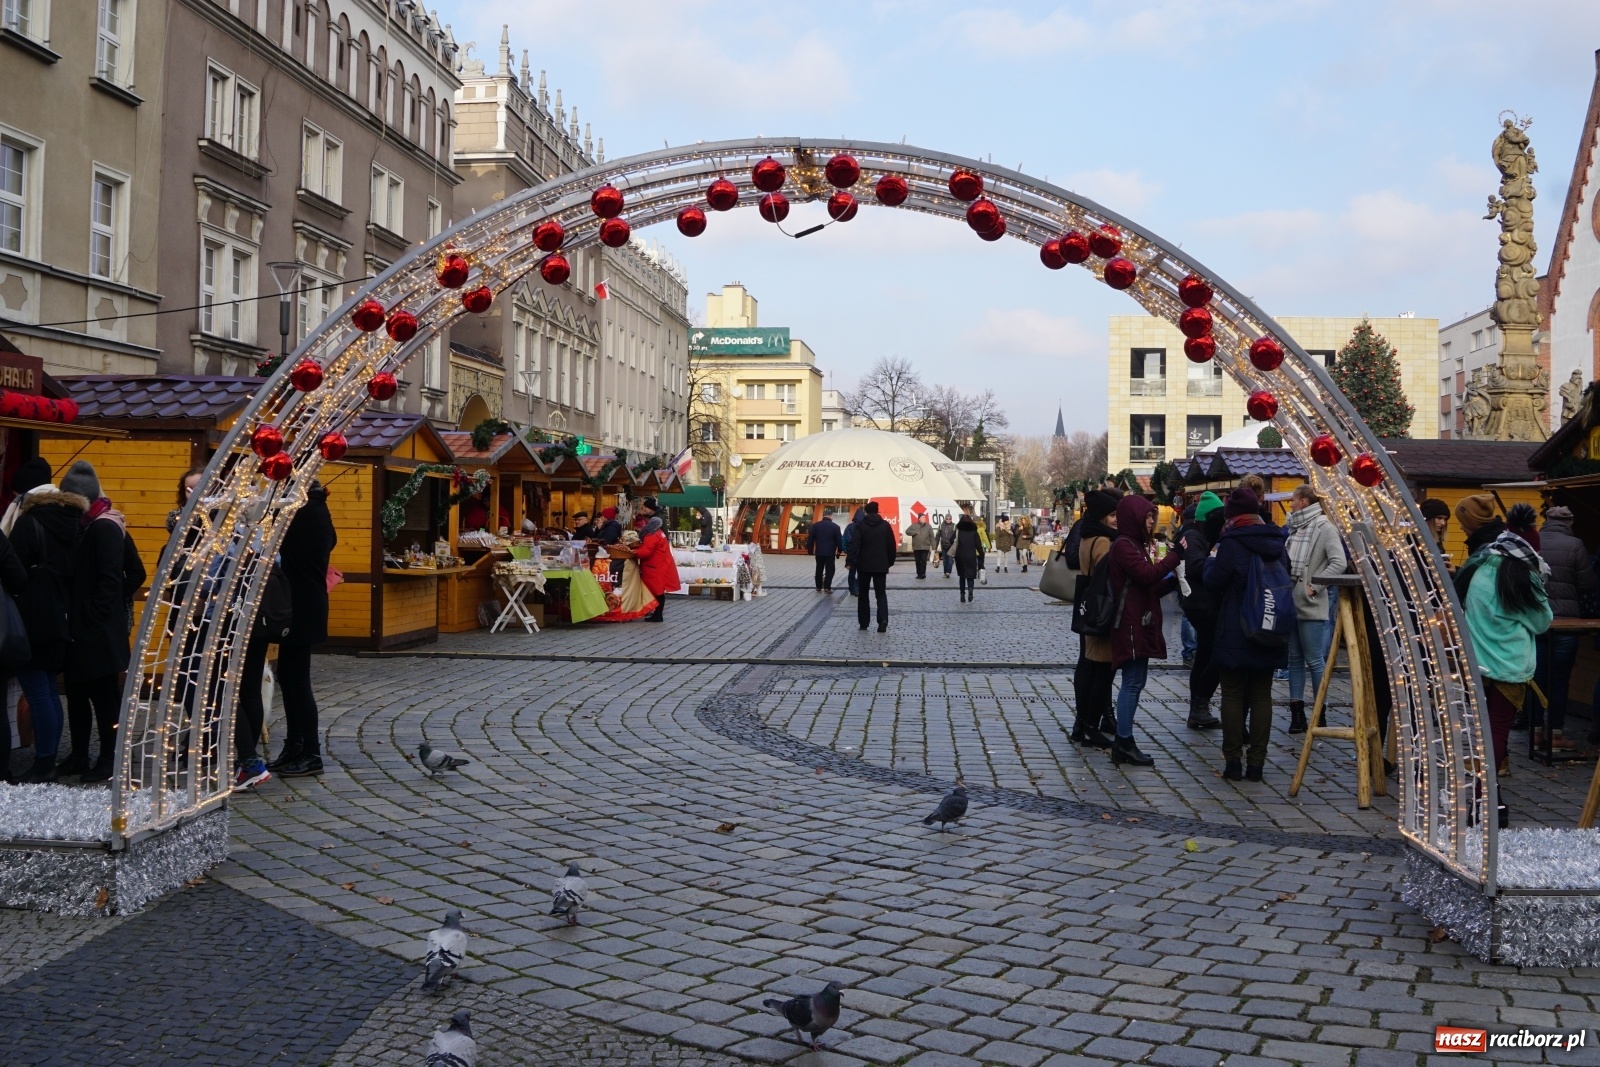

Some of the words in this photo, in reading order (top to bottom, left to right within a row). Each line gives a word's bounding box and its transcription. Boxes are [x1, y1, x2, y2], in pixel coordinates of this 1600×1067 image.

[710, 336, 764, 345] McDonald's
[803, 474, 830, 485] 1567
[1264, 588, 1276, 615] PUMA
